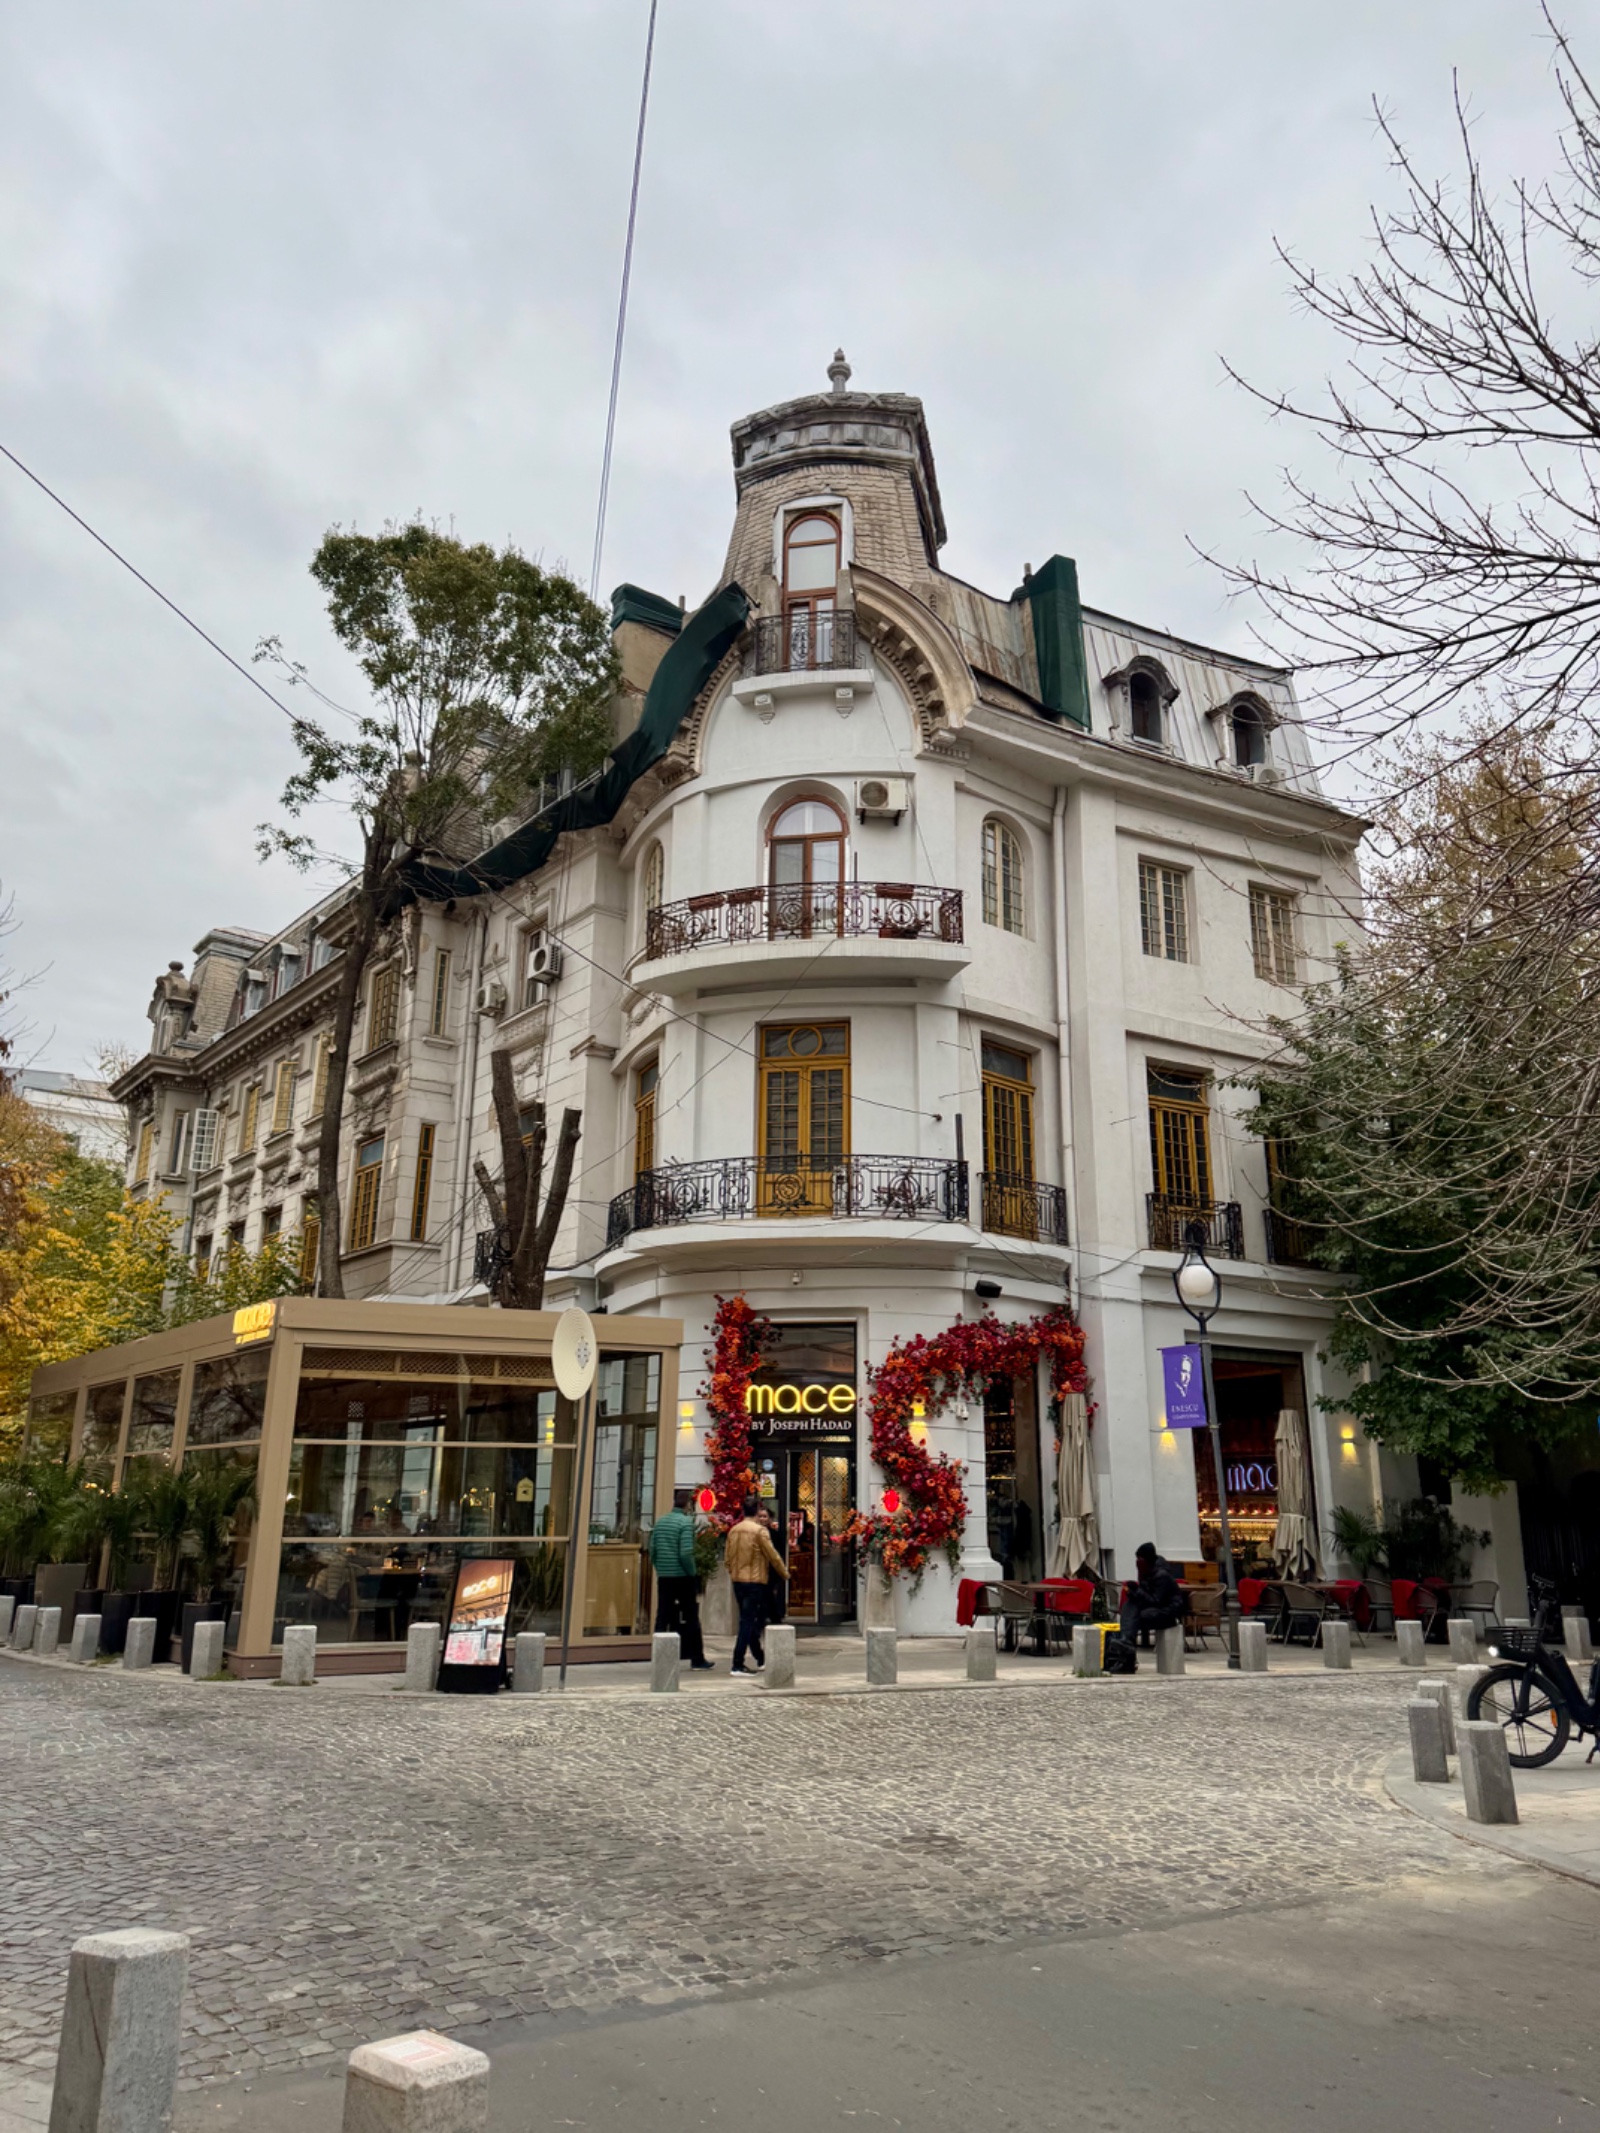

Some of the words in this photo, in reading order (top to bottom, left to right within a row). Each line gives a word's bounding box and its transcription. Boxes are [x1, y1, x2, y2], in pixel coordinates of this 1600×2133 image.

[746, 1384, 857, 1414] mace
[751, 1420, 766, 1430] BY
[767, 1418, 808, 1436] JOSEPH
[810, 1418, 852, 1430] HADAD
[1227, 1463, 1279, 1491] mac
